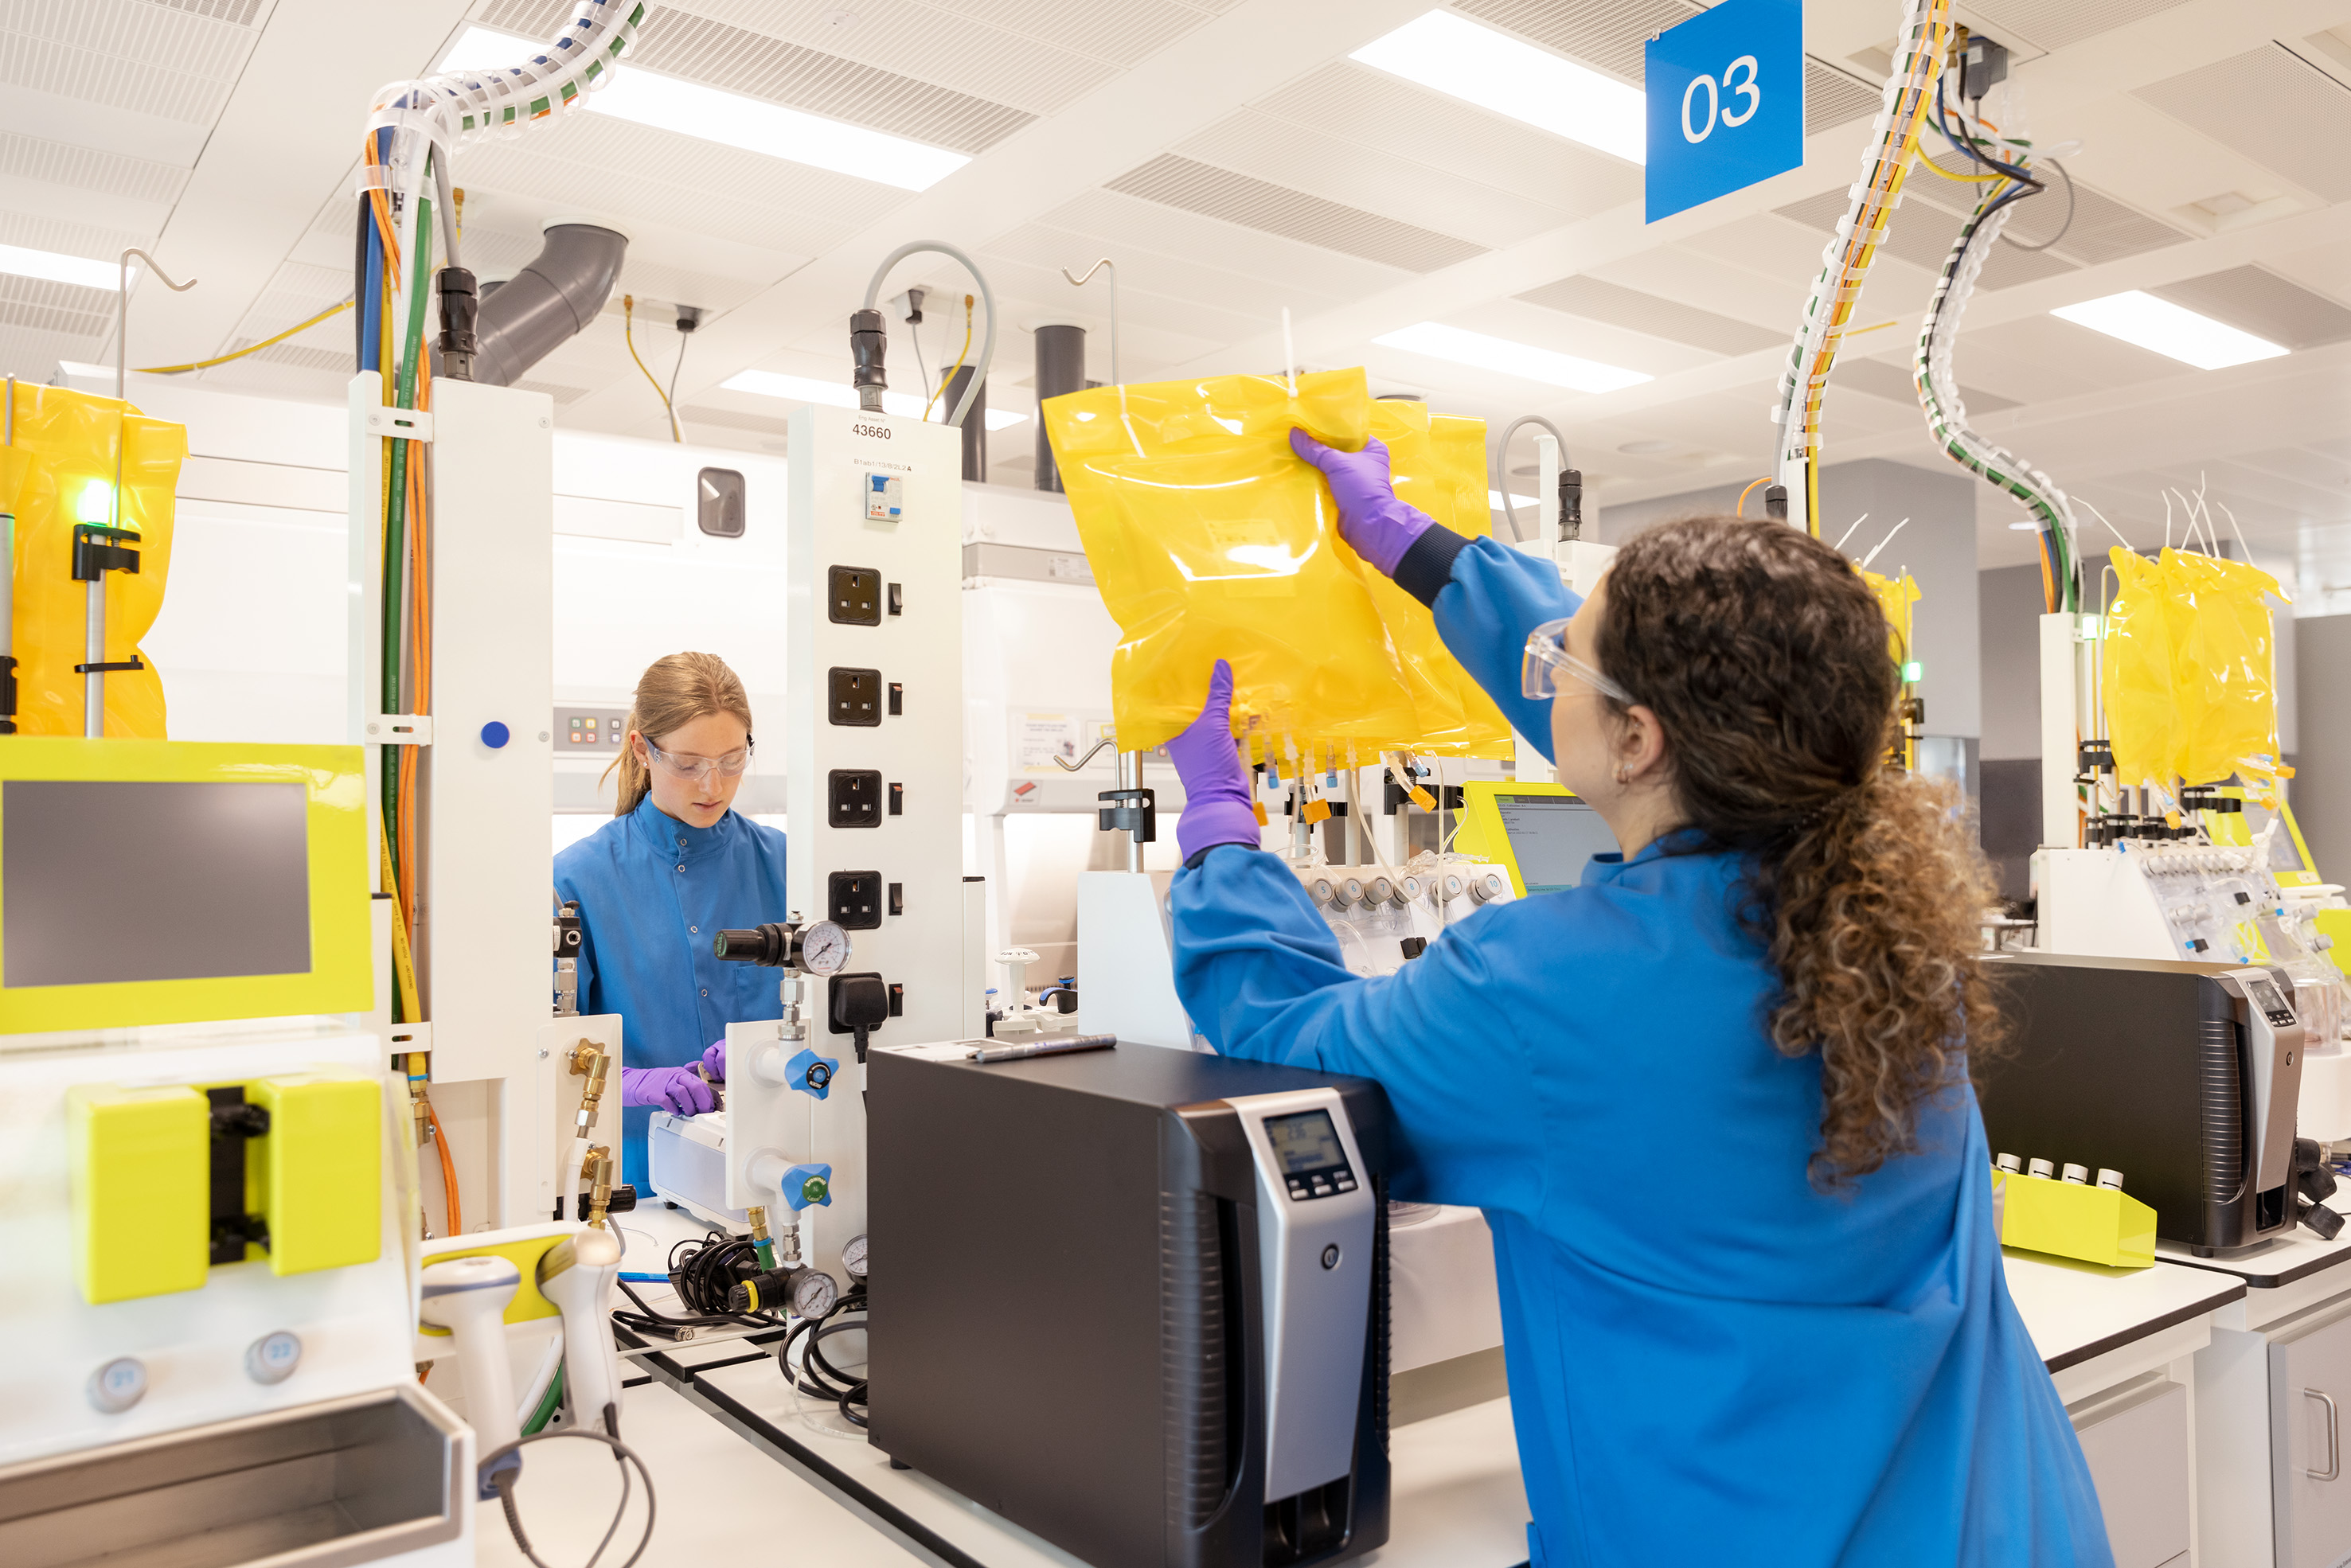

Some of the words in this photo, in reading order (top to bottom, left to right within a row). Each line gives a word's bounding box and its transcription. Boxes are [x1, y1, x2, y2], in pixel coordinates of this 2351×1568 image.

[1681, 54, 1762, 144] 03
[853, 424, 892, 439] 43660
[271, 1341, 293, 1360] 22
[113, 1368, 136, 1390] 21
